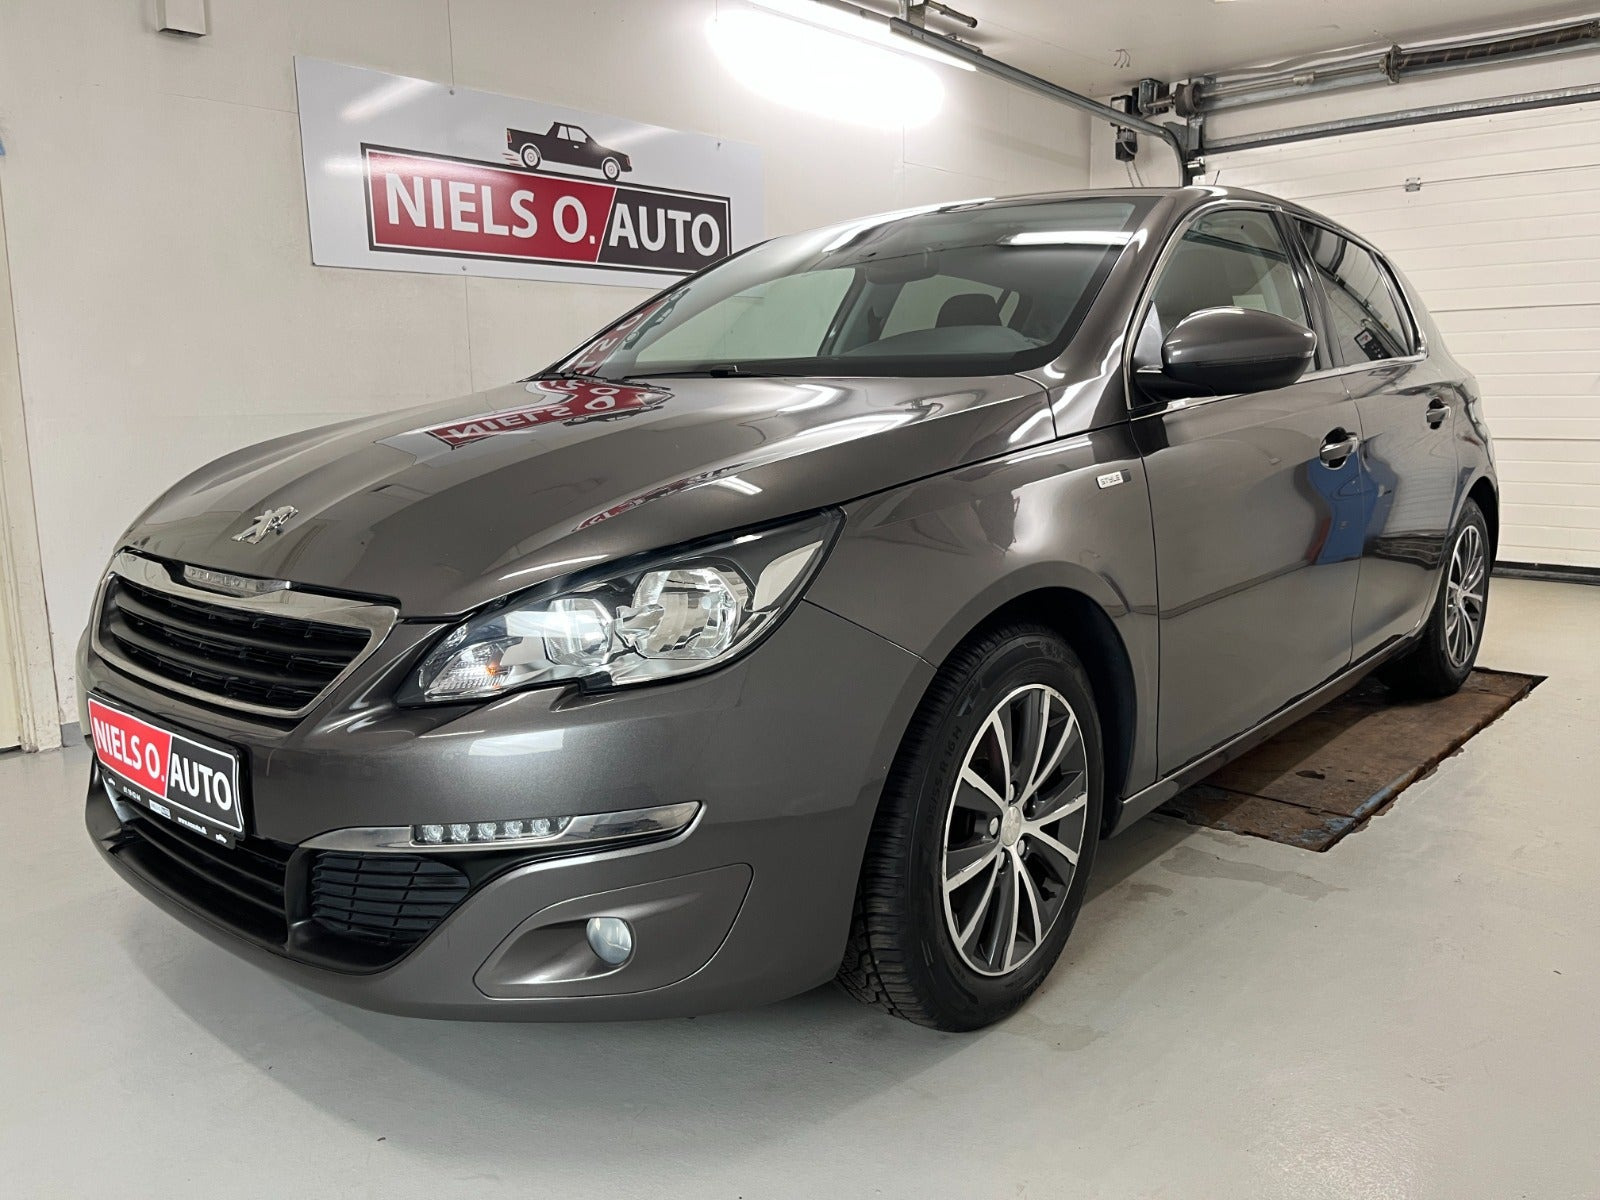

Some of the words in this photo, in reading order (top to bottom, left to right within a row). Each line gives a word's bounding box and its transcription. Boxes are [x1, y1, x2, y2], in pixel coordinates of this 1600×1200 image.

[386, 173, 537, 239] NIELS
[553, 196, 596, 244] O.
[609, 203, 721, 256] AUTO
[93, 717, 142, 771] NIELS
[145, 742, 165, 782] O.
[170, 752, 232, 811] AUTO
